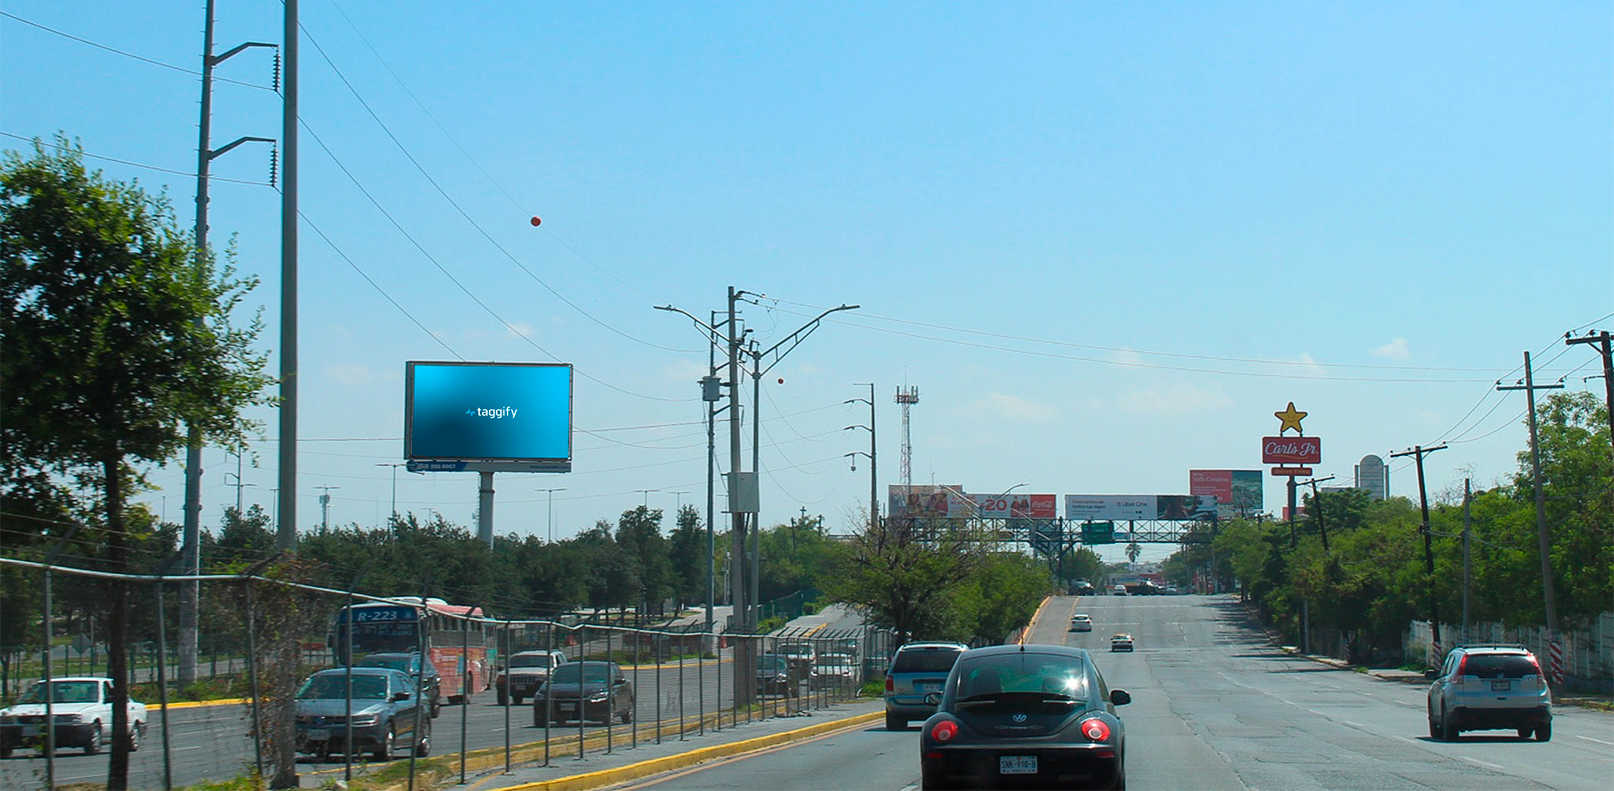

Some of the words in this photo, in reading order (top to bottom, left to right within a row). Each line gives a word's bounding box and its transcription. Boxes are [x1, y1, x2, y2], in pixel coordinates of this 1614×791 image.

[477, 406, 518, 419] taggify
[1265, 441, 1298, 455] Carl's
[1299, 442, 1319, 456] Jr.
[357, 610, 397, 621] R-223
